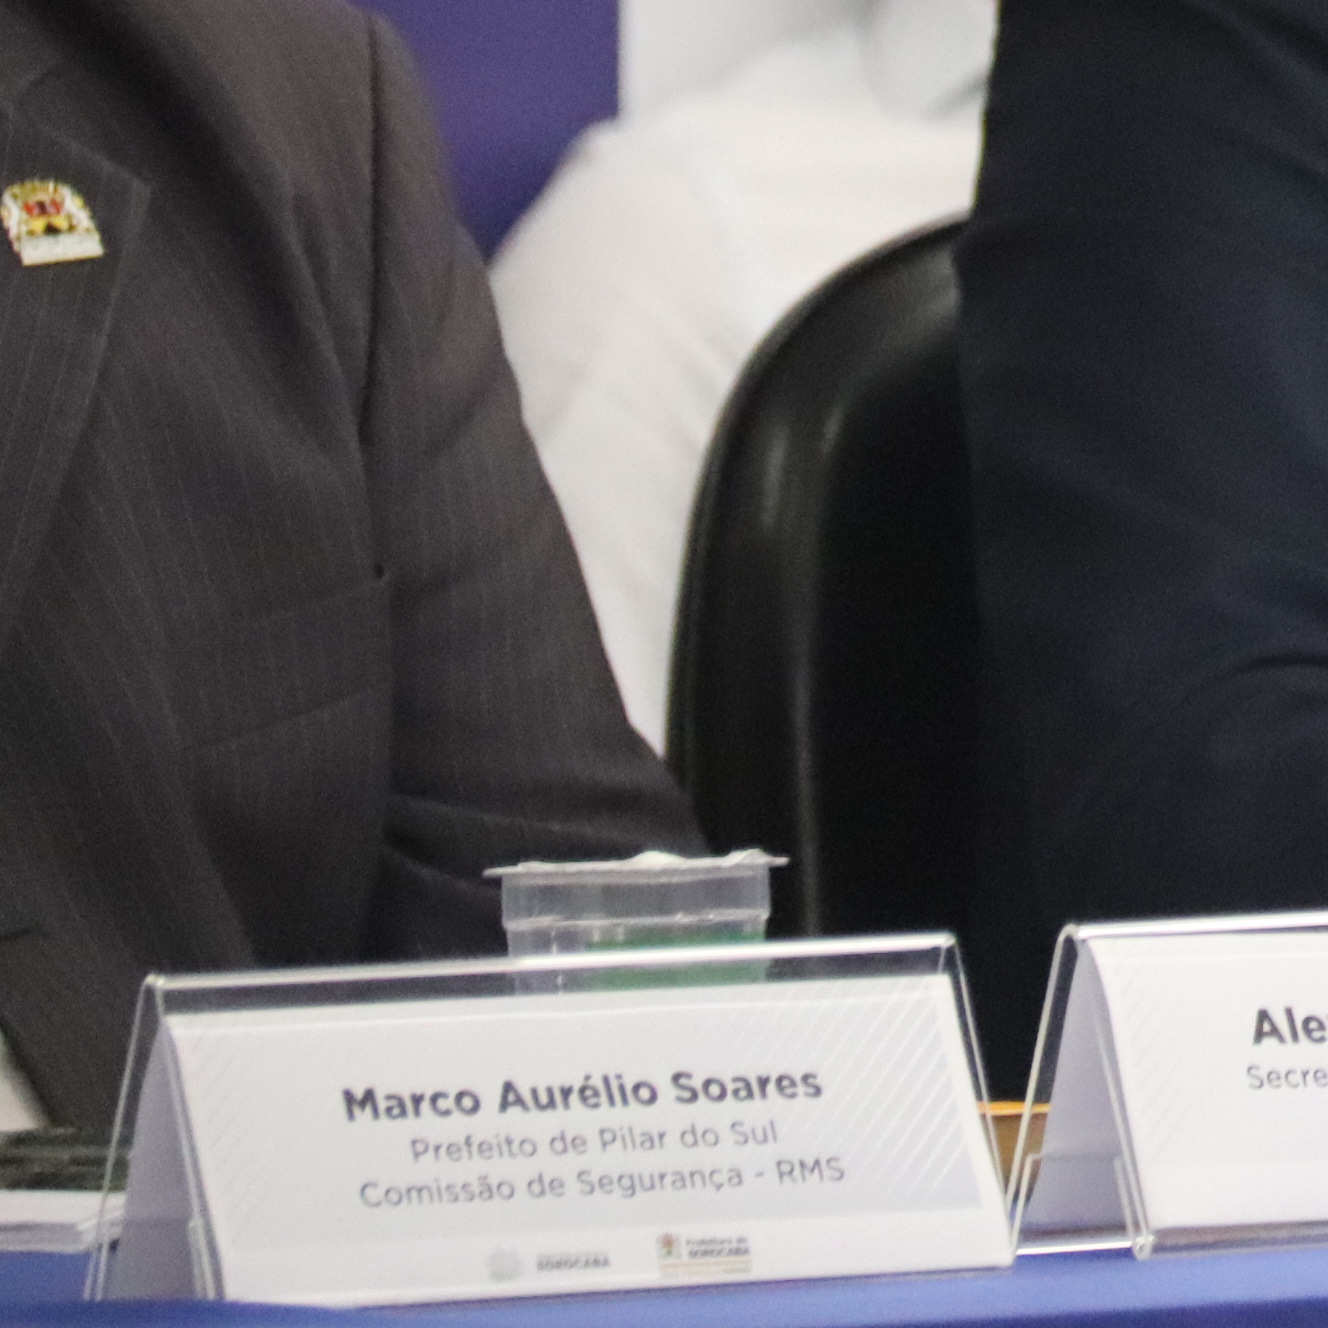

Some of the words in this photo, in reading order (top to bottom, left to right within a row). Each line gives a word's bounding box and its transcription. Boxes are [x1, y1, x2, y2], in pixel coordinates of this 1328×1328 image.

[341, 1087, 482, 1122] Marco
[498, 1073, 659, 1114] Aurélio
[670, 1070, 823, 1105] Soares
[409, 1133, 539, 1163] Prefeito
[548, 1129, 588, 1157] de
[597, 1125, 668, 1153] Pilar
[678, 1122, 721, 1149] do
[728, 1118, 779, 1147] Sul
[358, 1173, 516, 1209] Comissão
[525, 1171, 566, 1200] de
[575, 1166, 745, 1200] Segurança
[774, 1155, 846, 1185] RMS
